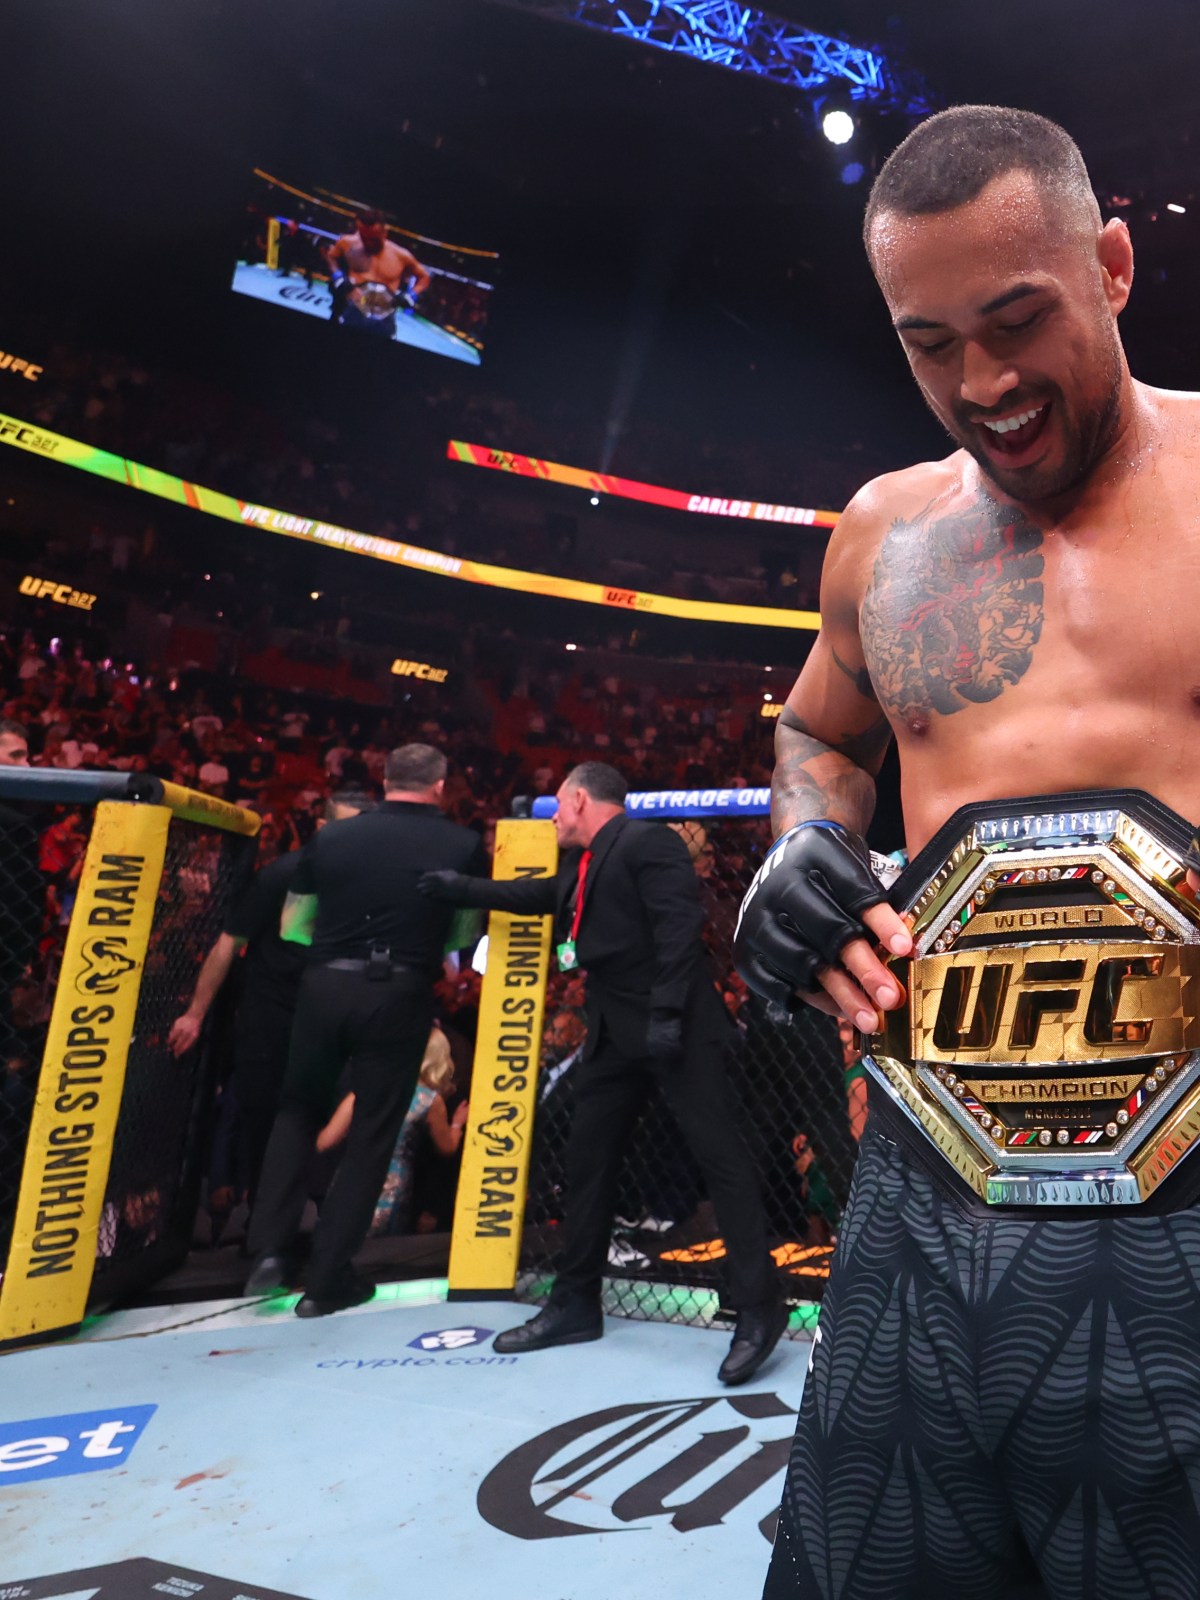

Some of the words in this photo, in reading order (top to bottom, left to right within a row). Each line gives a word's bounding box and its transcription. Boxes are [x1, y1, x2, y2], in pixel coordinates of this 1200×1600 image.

[0, 420, 34, 444] FC
[688, 495, 751, 518] CARLOS
[754, 503, 816, 525] ULBERG
[241, 506, 271, 524] UFC
[272, 511, 314, 535] LIGHT
[314, 523, 400, 557] HEAVYWEIGHT
[402, 546, 462, 574] CHAMPION
[19, 576, 72, 604] UFC
[607, 591, 637, 606] UFC
[391, 659, 431, 679] UFC
[737, 787, 771, 806] ON
[88, 853, 146, 927] RAM
[994, 909, 1104, 928] WORLD
[931, 952, 1166, 1052] UFC
[54, 1004, 116, 1113] STOPS
[493, 998, 536, 1093] STOPS
[980, 1080, 1129, 1102] CHAMPION
[26, 1120, 96, 1279] NOTHING
[475, 1166, 519, 1238] RAM
[316, 1355, 518, 1370] crypto.com
